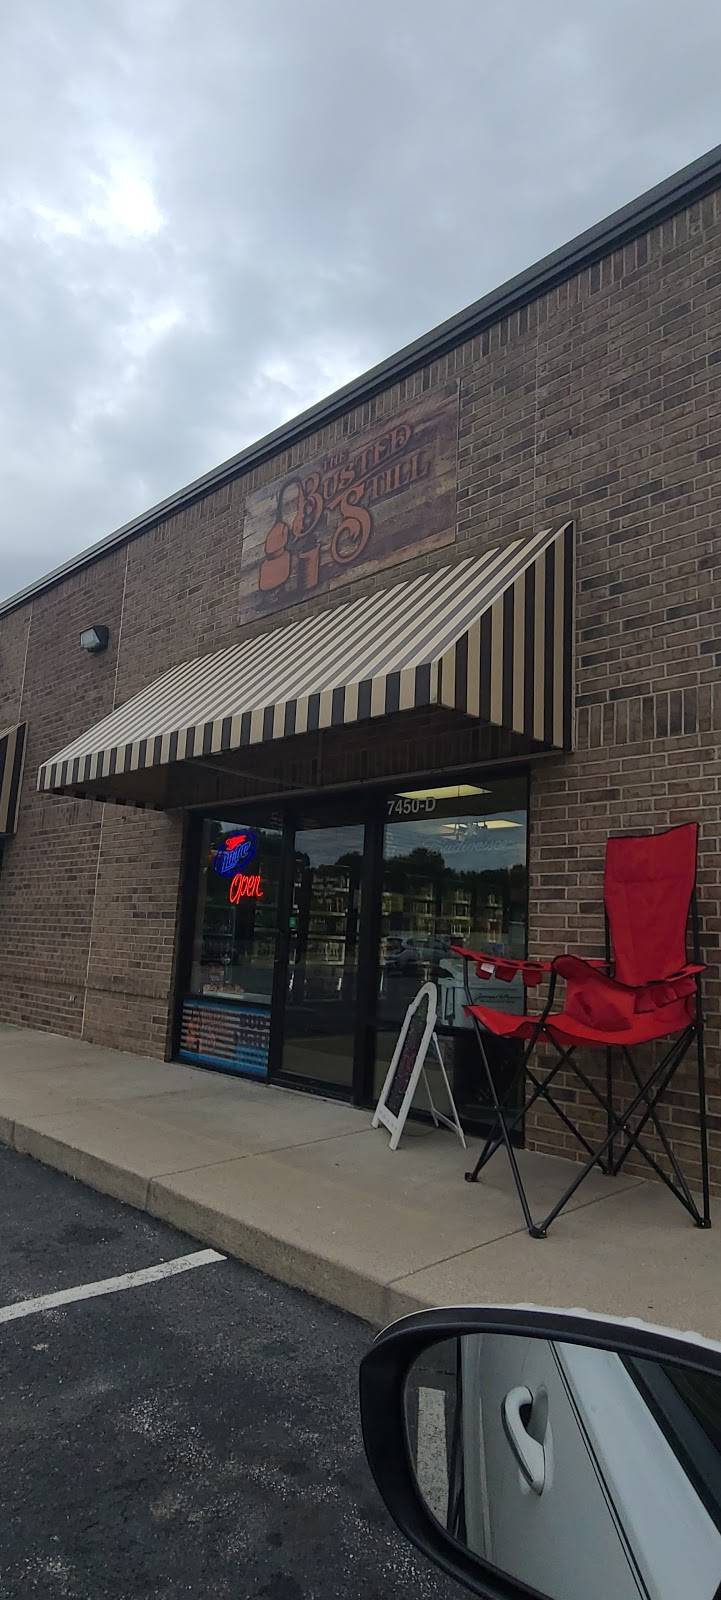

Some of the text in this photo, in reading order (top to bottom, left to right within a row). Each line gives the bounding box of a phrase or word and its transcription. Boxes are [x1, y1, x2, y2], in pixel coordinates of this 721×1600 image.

[322, 449, 349, 473] THE
[329, 453, 429, 564] STILL
[386, 796, 437, 816] 7450-D
[229, 873, 264, 905] Open
